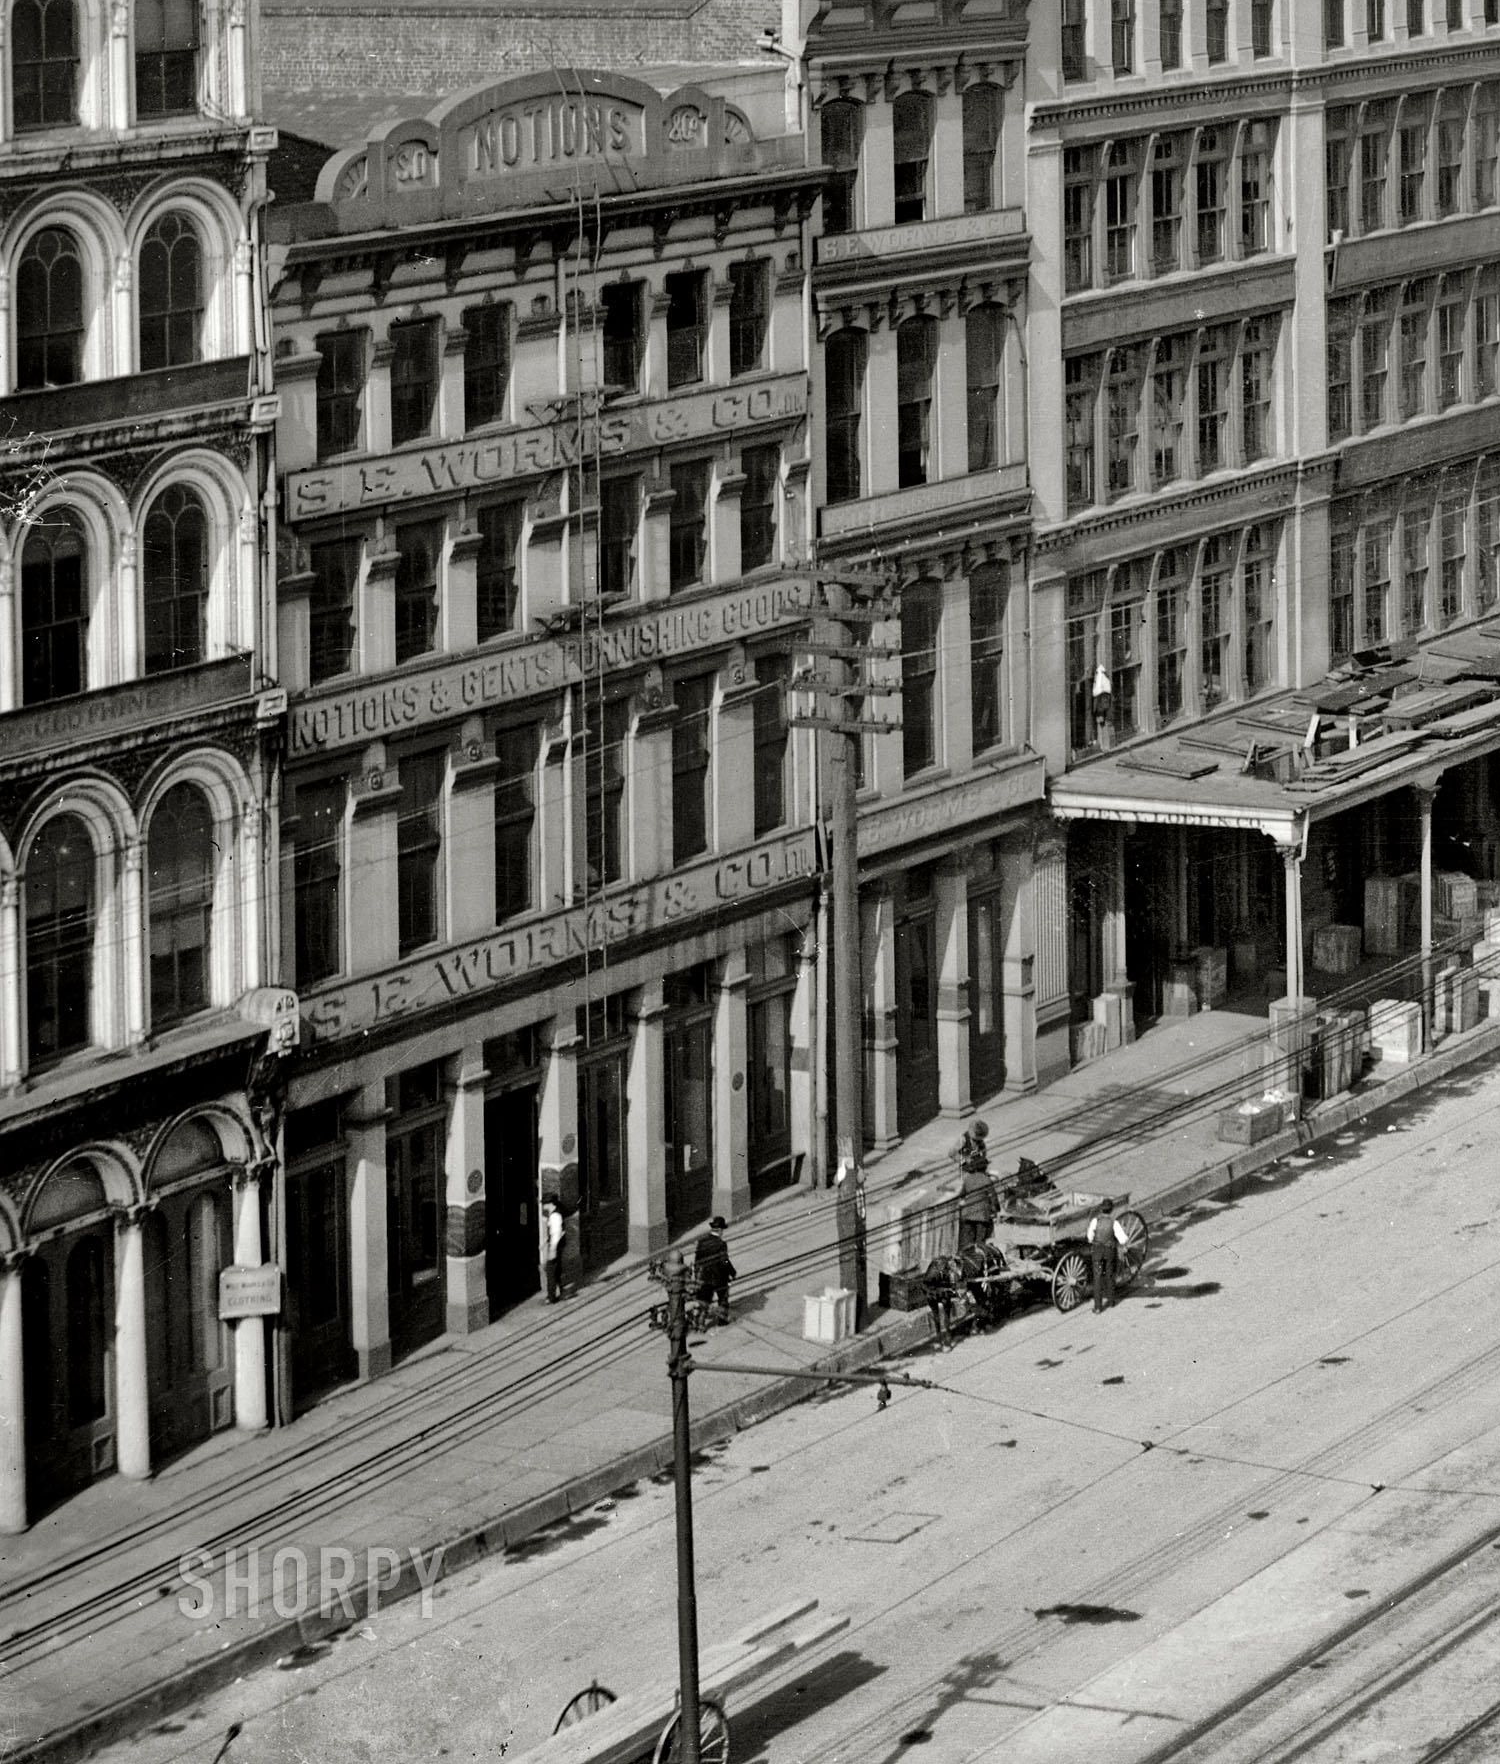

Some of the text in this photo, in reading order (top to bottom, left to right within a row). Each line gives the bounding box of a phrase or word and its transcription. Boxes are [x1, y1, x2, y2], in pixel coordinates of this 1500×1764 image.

[473, 104, 630, 172] NOTIONS
[420, 420, 631, 493] WORMS
[654, 407, 690, 442] &
[290, 685, 419, 754] NOTIONS
[427, 680, 452, 717] &
[560, 608, 713, 680] FURNISHING
[435, 896, 639, 995] WORMS
[664, 881, 698, 919] &
